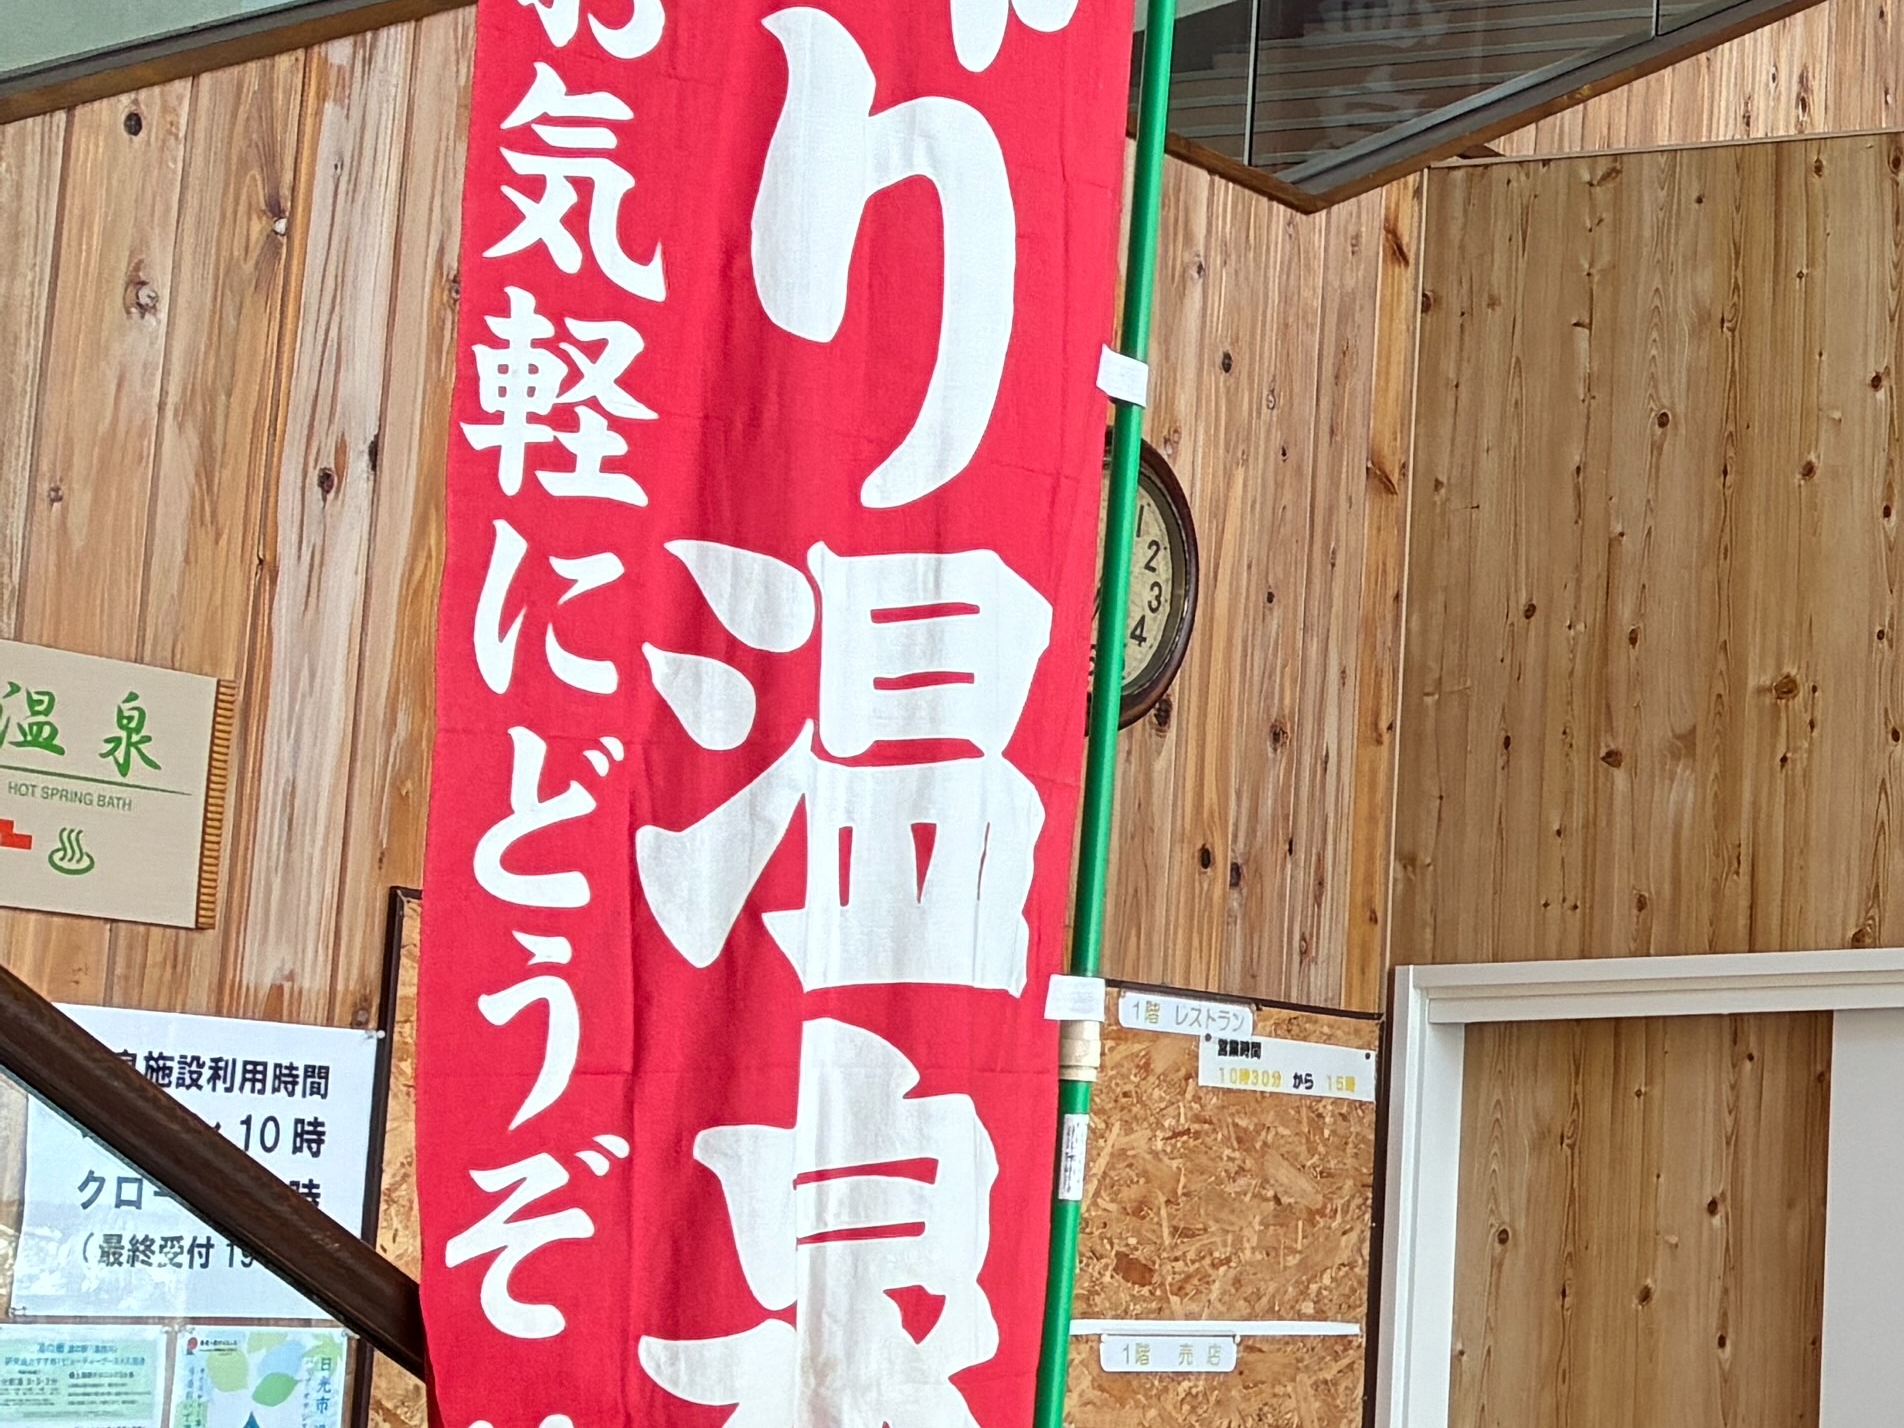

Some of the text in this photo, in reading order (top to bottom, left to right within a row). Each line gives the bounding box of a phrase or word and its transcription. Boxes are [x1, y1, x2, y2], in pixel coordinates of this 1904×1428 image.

[1144, 539, 1161, 573] 2
[1147, 581, 1162, 614] 3
[1129, 614, 1147, 647] 4
[8, 781, 133, 812] HOT SPRING BATH
[1175, 1005, 1245, 1032] レストラン
[1217, 1038, 1262, 1060] 営業時間
[1292, 1072, 1315, 1091] から
[1177, 1341, 1223, 1366] 売店
